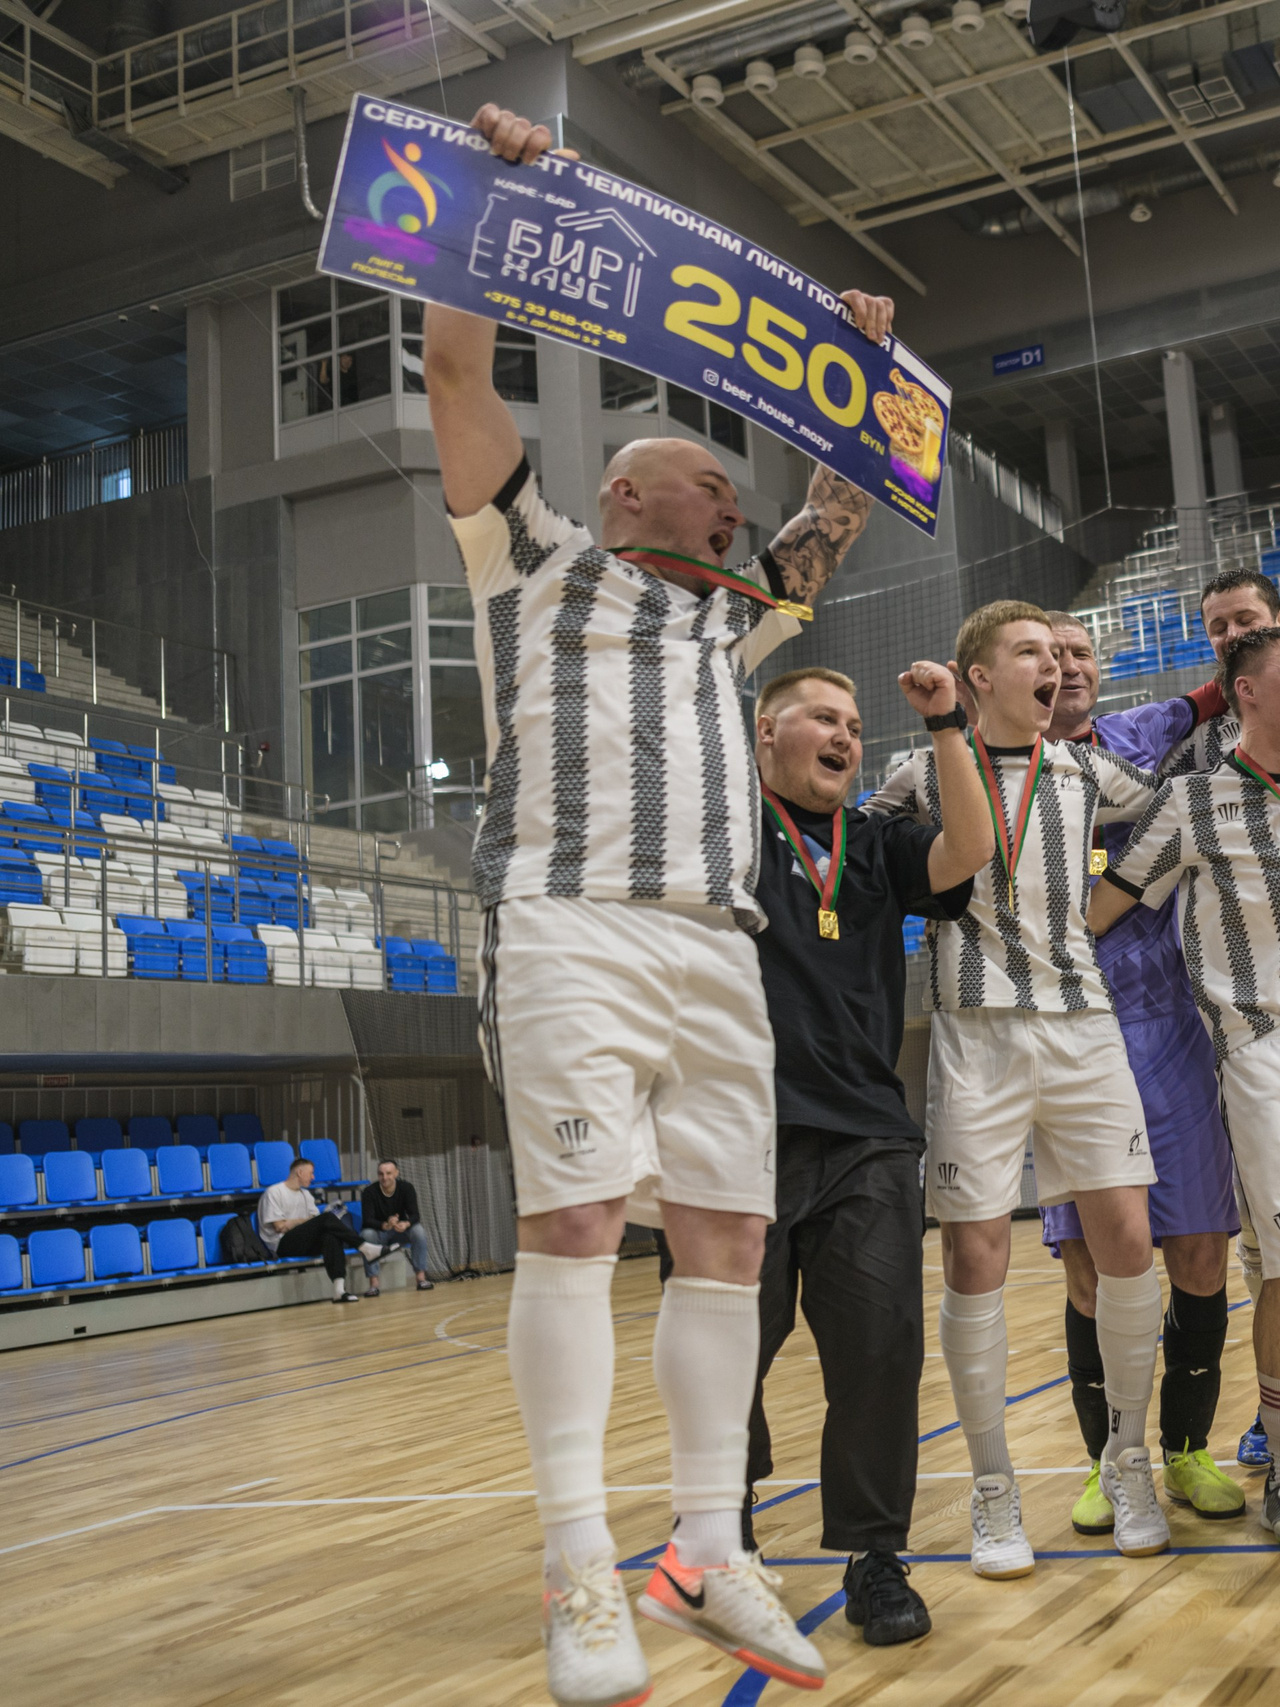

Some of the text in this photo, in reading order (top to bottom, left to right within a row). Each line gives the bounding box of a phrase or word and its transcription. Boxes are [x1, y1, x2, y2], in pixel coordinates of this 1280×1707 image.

[362, 103, 891, 353] СЕРТИФАТ ЧЕМПИОНАМ ЛИГИ ПОЛЕЯ
[507, 218, 623, 281] БИР
[484, 290, 522, 309] +375
[523, 301, 547, 317] 33
[663, 264, 868, 428] 250
[1021, 348, 1042, 366] D1
[721, 377, 835, 454] beer_house_mozyr
[859, 429, 886, 456] BYN
